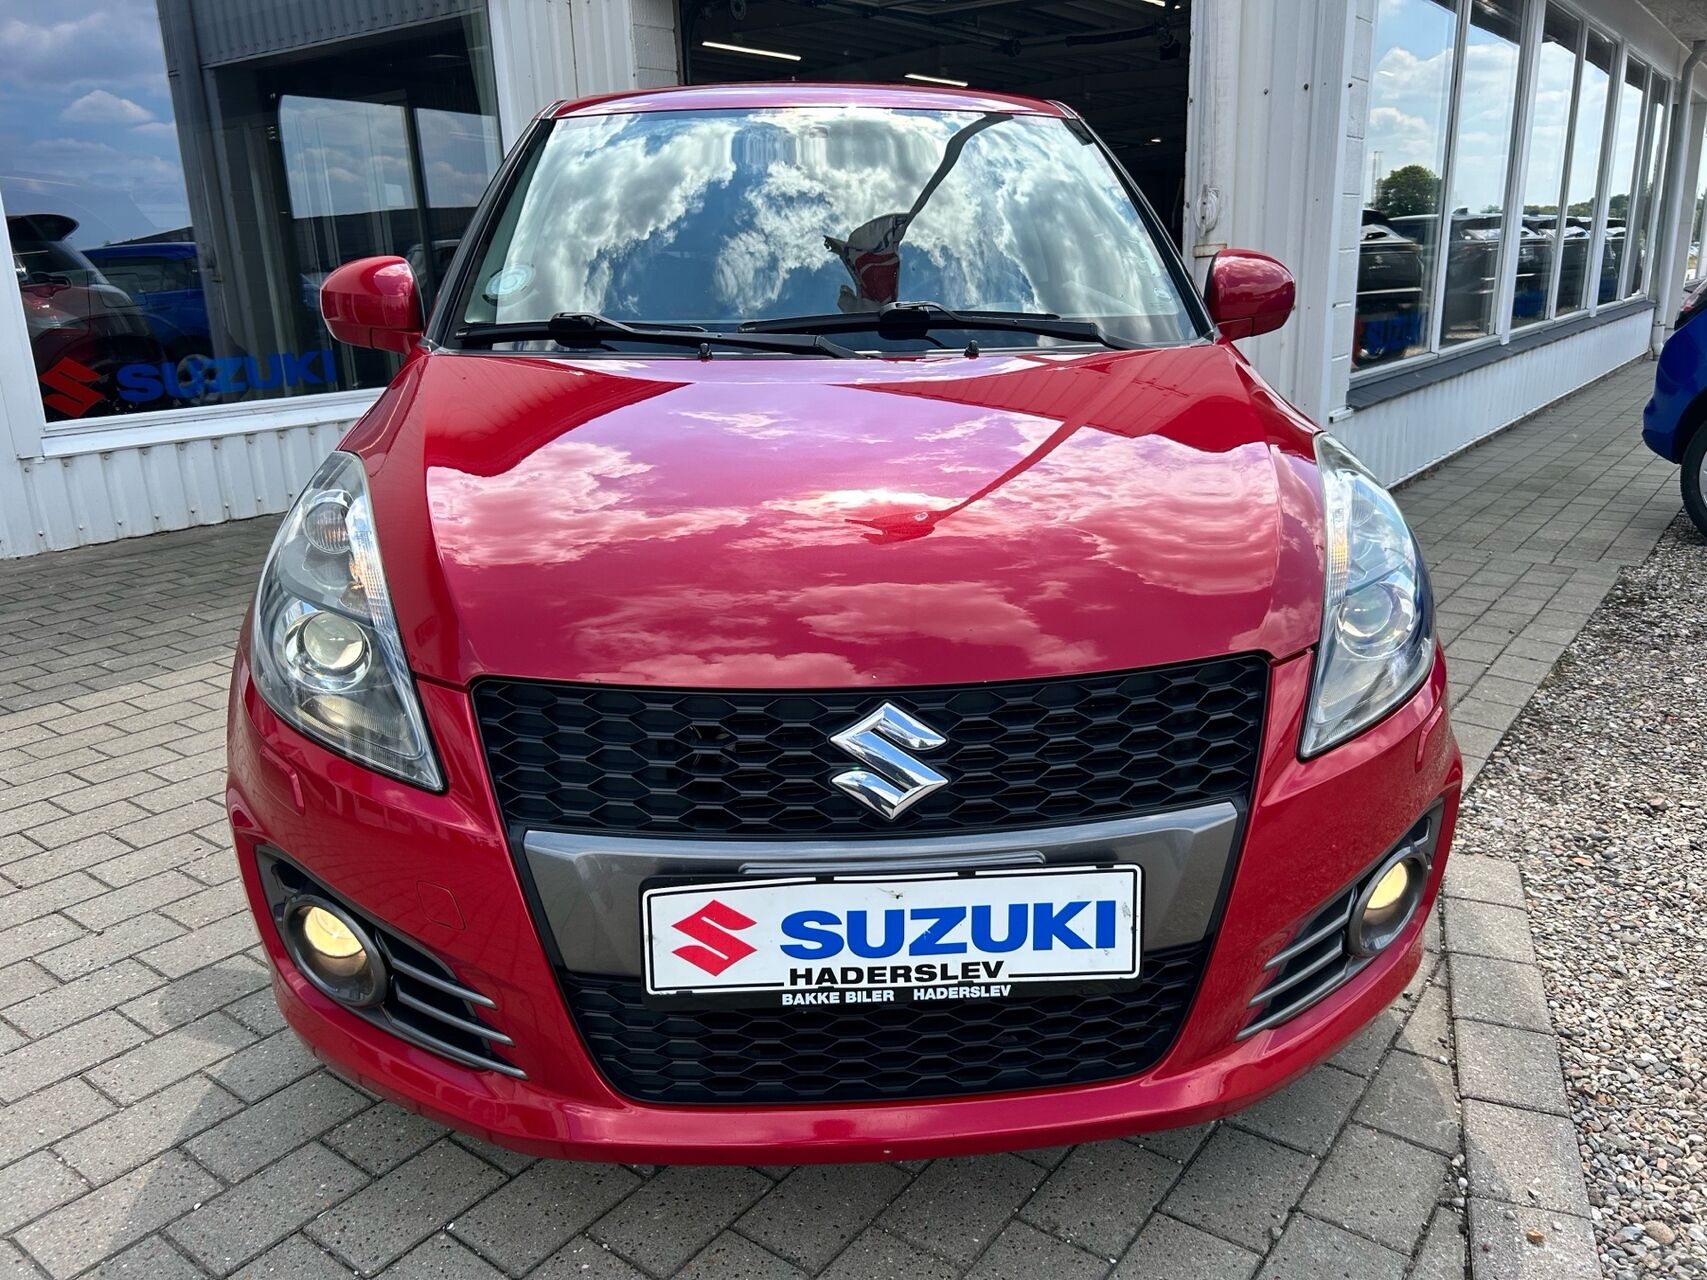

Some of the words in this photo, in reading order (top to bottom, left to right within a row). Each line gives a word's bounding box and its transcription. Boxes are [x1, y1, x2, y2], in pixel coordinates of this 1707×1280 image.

[116, 350, 337, 403] SUZUKI
[780, 900, 1116, 960] SUZUKI
[790, 960, 1004, 986] HADERSLEV
[782, 991, 840, 1006] BAKKE
[845, 989, 895, 1003] BILER
[913, 984, 1012, 1001] HADERSLEV
